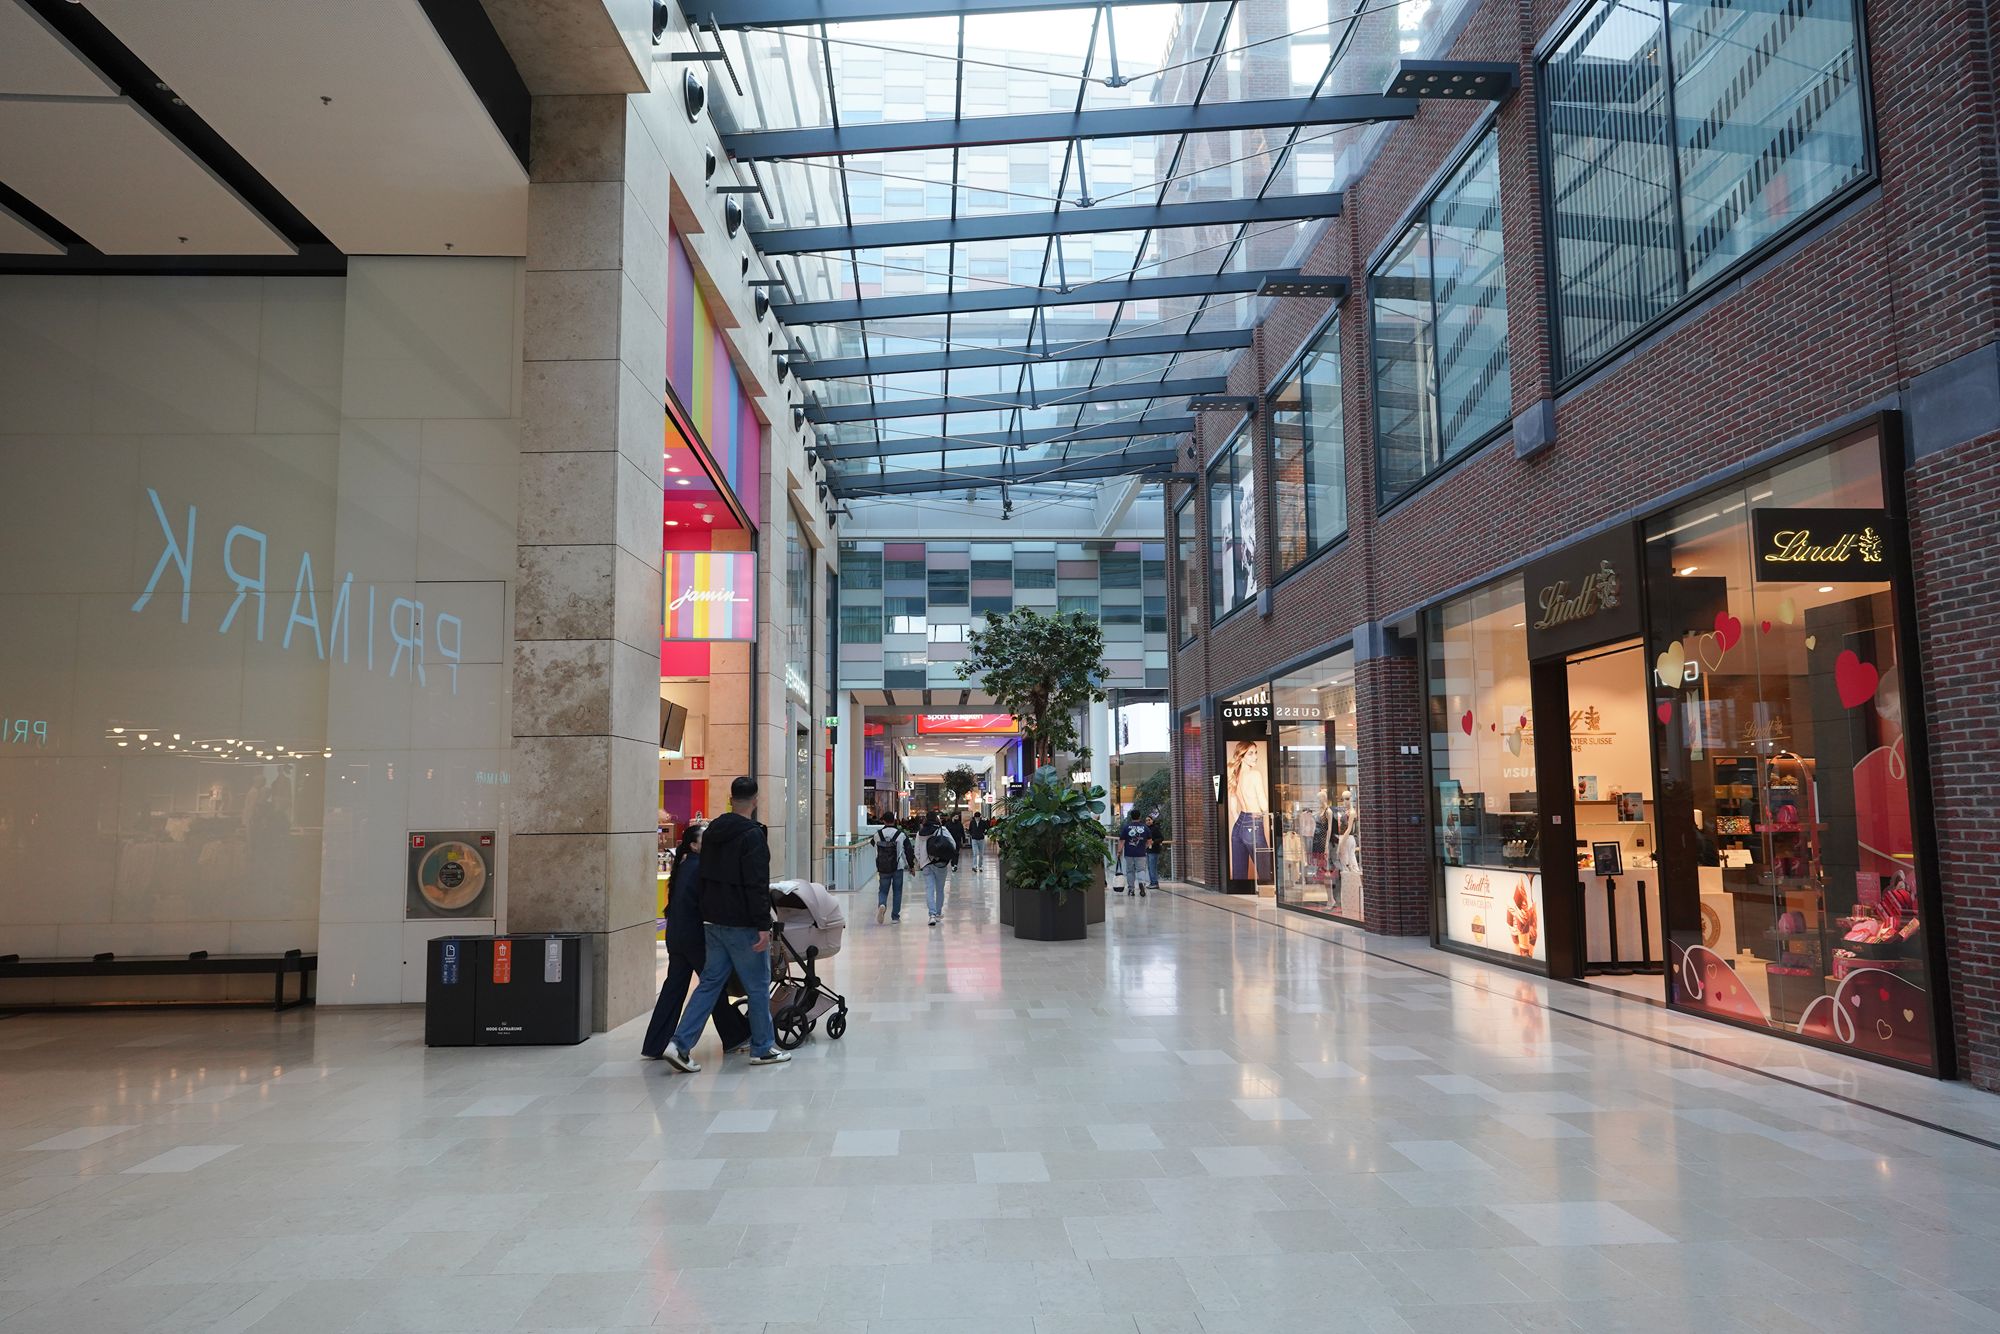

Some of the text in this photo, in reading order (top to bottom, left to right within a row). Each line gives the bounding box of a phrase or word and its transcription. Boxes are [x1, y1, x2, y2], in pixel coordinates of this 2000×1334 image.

[1765, 528, 1857, 563] Lindt
[669, 585, 749, 611] jamin
[1533, 573, 1599, 631] Lindt
[1223, 706, 1269, 718] GUESS
[1743, 720, 1774, 739] Lindt
[1589, 737, 1613, 746] SUISSE
[1463, 874, 1484, 891] Lindt
